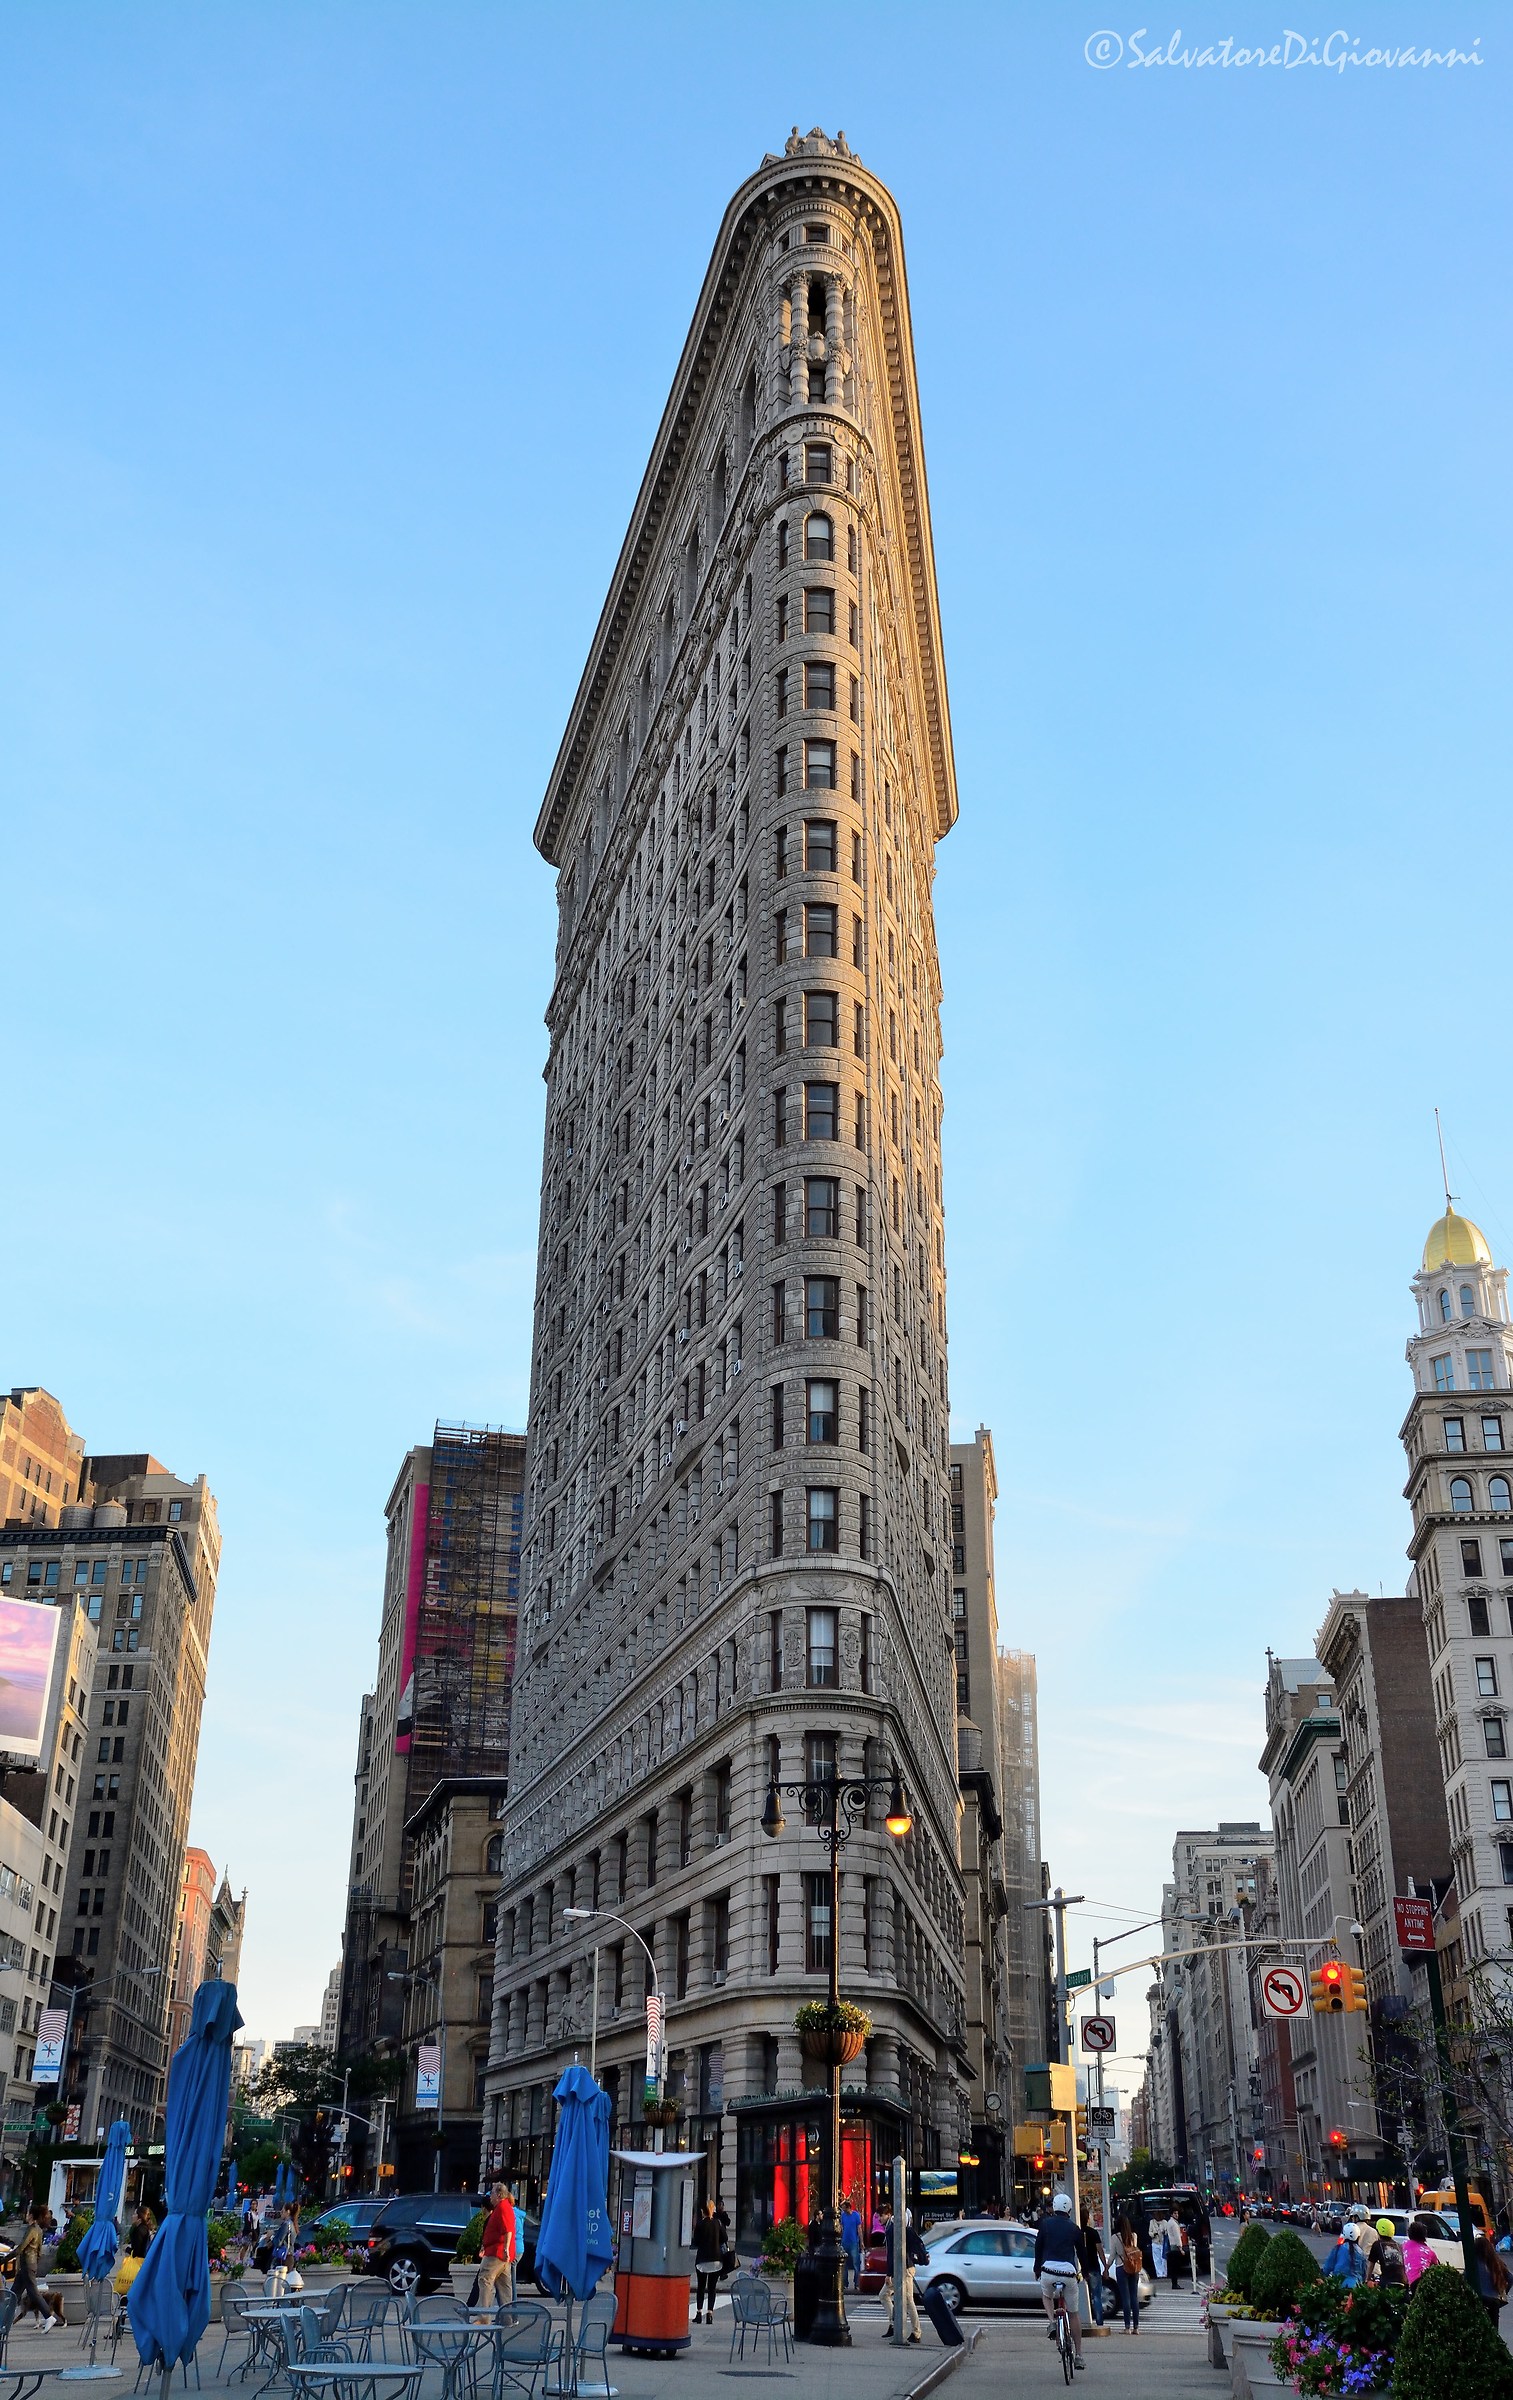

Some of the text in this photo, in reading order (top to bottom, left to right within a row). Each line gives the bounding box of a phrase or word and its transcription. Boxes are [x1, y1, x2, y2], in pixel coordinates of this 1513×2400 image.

[1396, 1903, 1429, 1917] NO STOPPING
[1404, 1918, 1426, 1930] ANYTIME
[1068, 1971, 1089, 1986] Broadway
[623, 2211, 632, 2232] map
